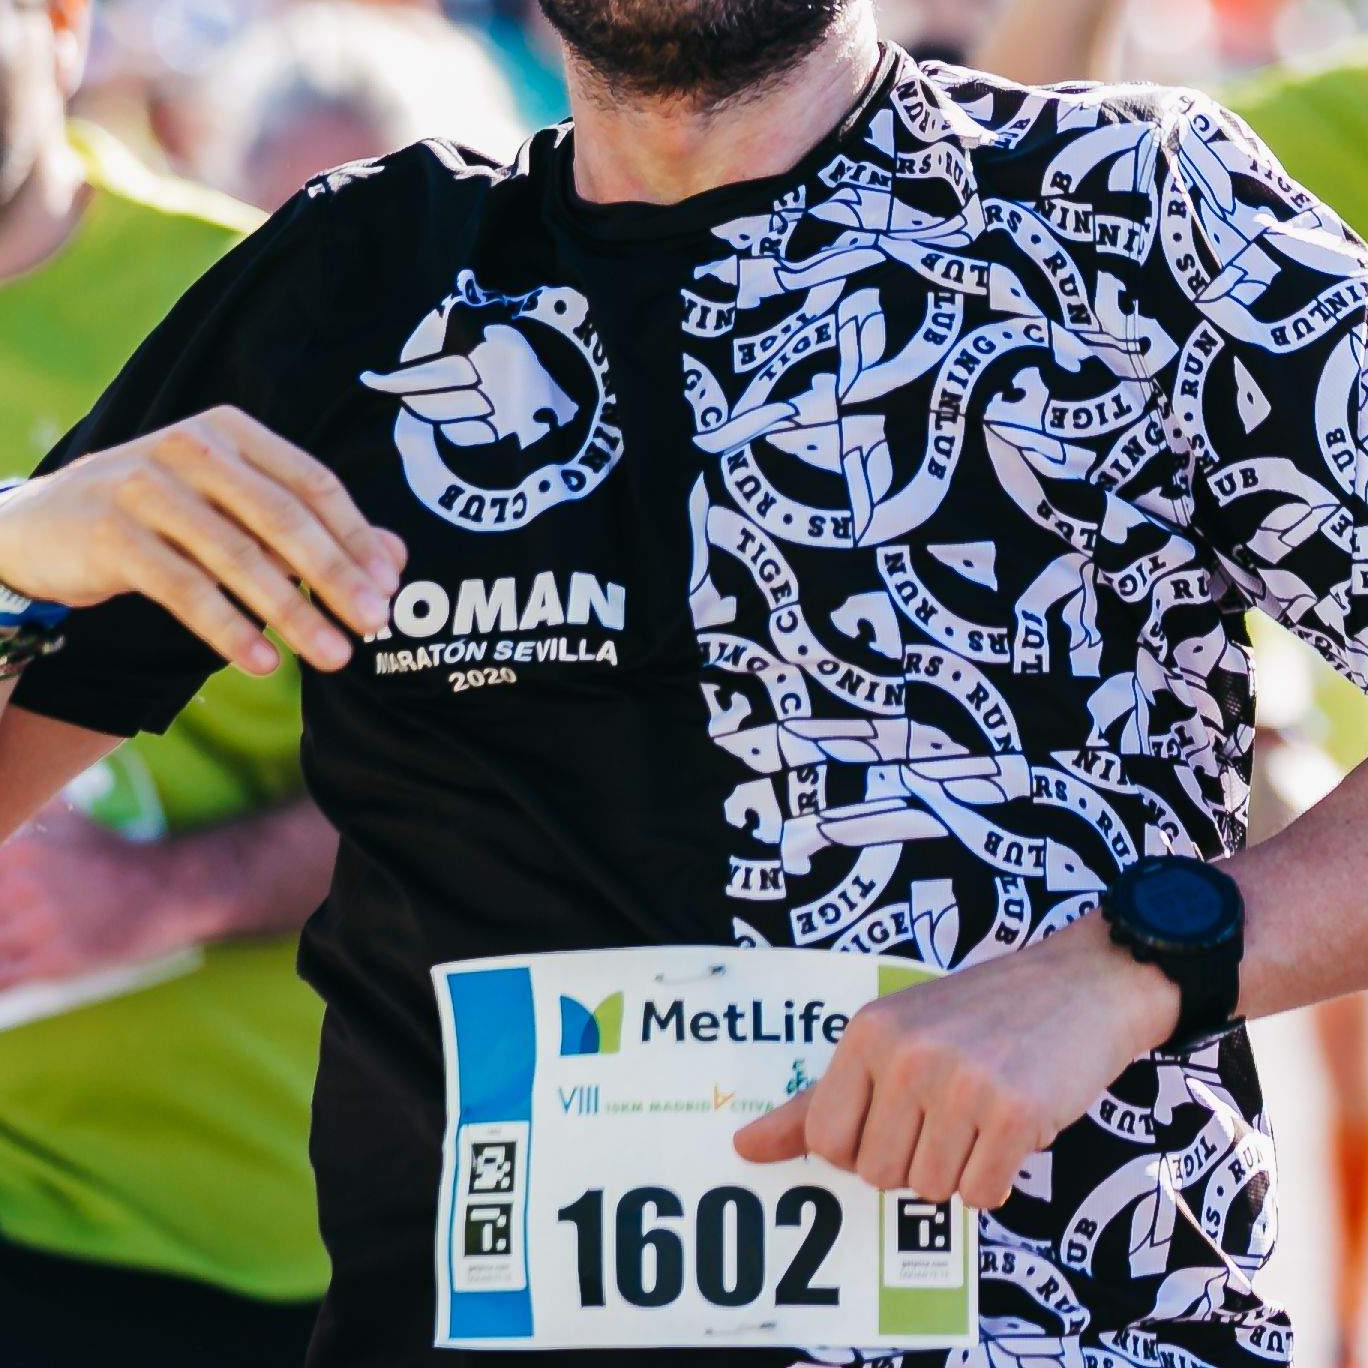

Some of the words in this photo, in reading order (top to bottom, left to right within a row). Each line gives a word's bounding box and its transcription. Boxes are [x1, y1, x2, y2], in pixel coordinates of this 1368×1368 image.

[362, 570, 625, 643] OMAN
[493, 636, 618, 667] SEVILLA
[448, 666, 518, 693] 2020
[641, 999, 850, 1044] MetLife
[557, 1185, 844, 1308] 1602
